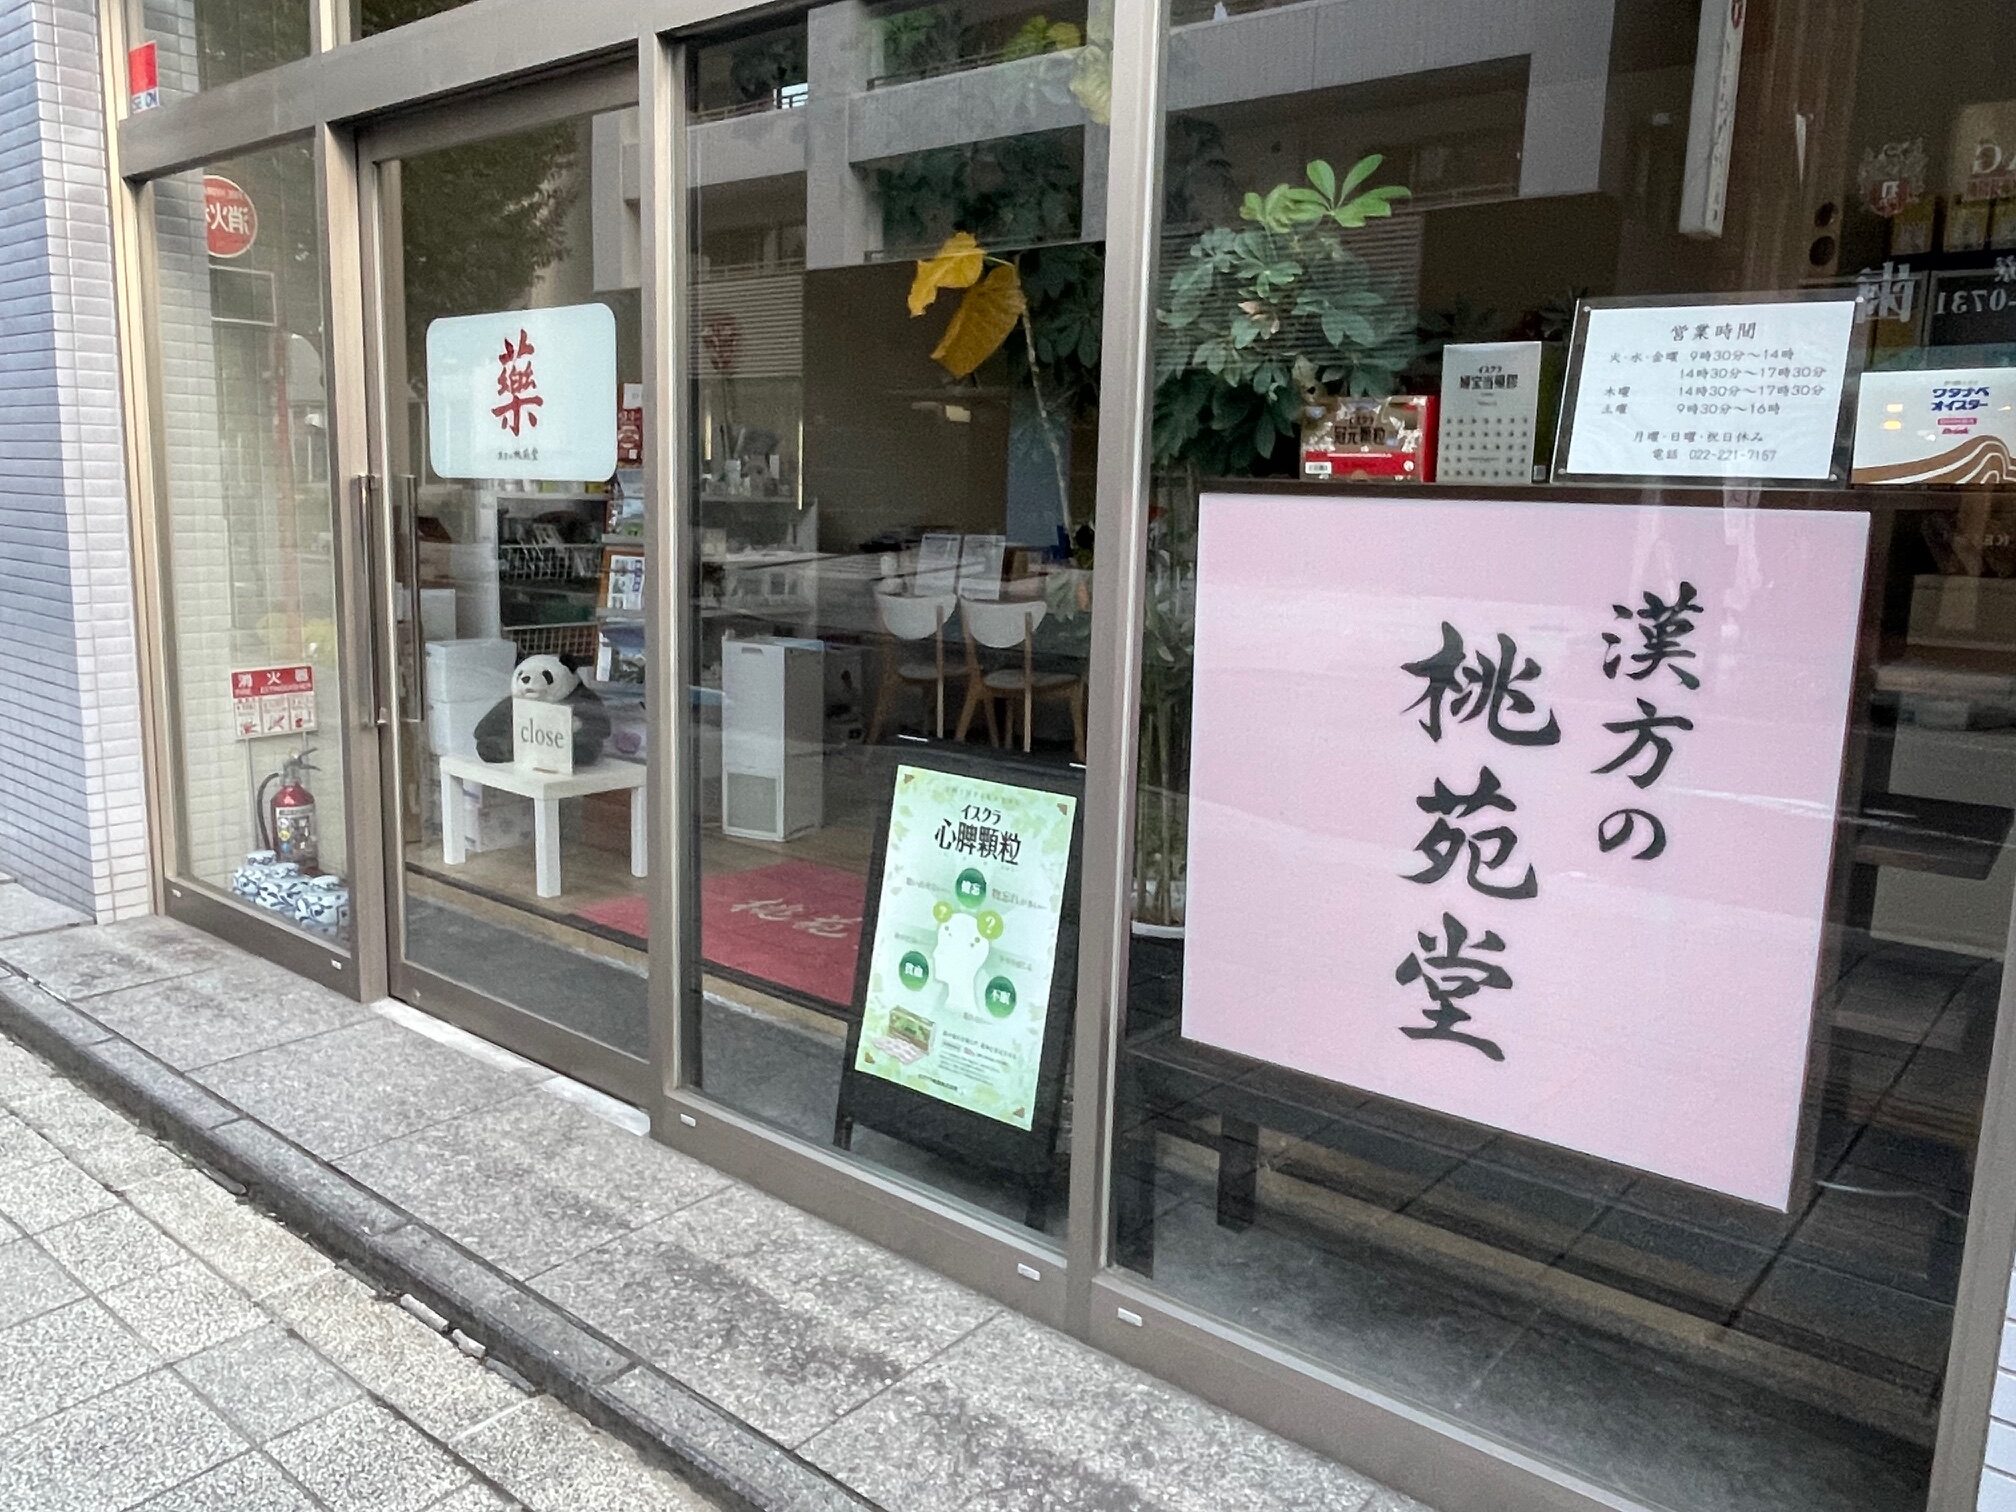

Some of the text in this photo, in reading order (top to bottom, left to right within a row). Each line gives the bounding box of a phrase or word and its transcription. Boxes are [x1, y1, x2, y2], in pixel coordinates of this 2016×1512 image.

[1670, 321, 1757, 342] 営業時間
[1604, 385, 1632, 399] 木曜
[1601, 402, 1629, 416] 土曜
[1930, 399, 1989, 412] オイスター
[1652, 448, 1679, 461] 電話
[1590, 581, 1704, 860] 漢方の
[521, 717, 565, 749] close
[960, 804, 1003, 826] イスクラ
[934, 818, 1022, 866] 心脾顆粒
[1394, 620, 1562, 1062] 桃苑堂
